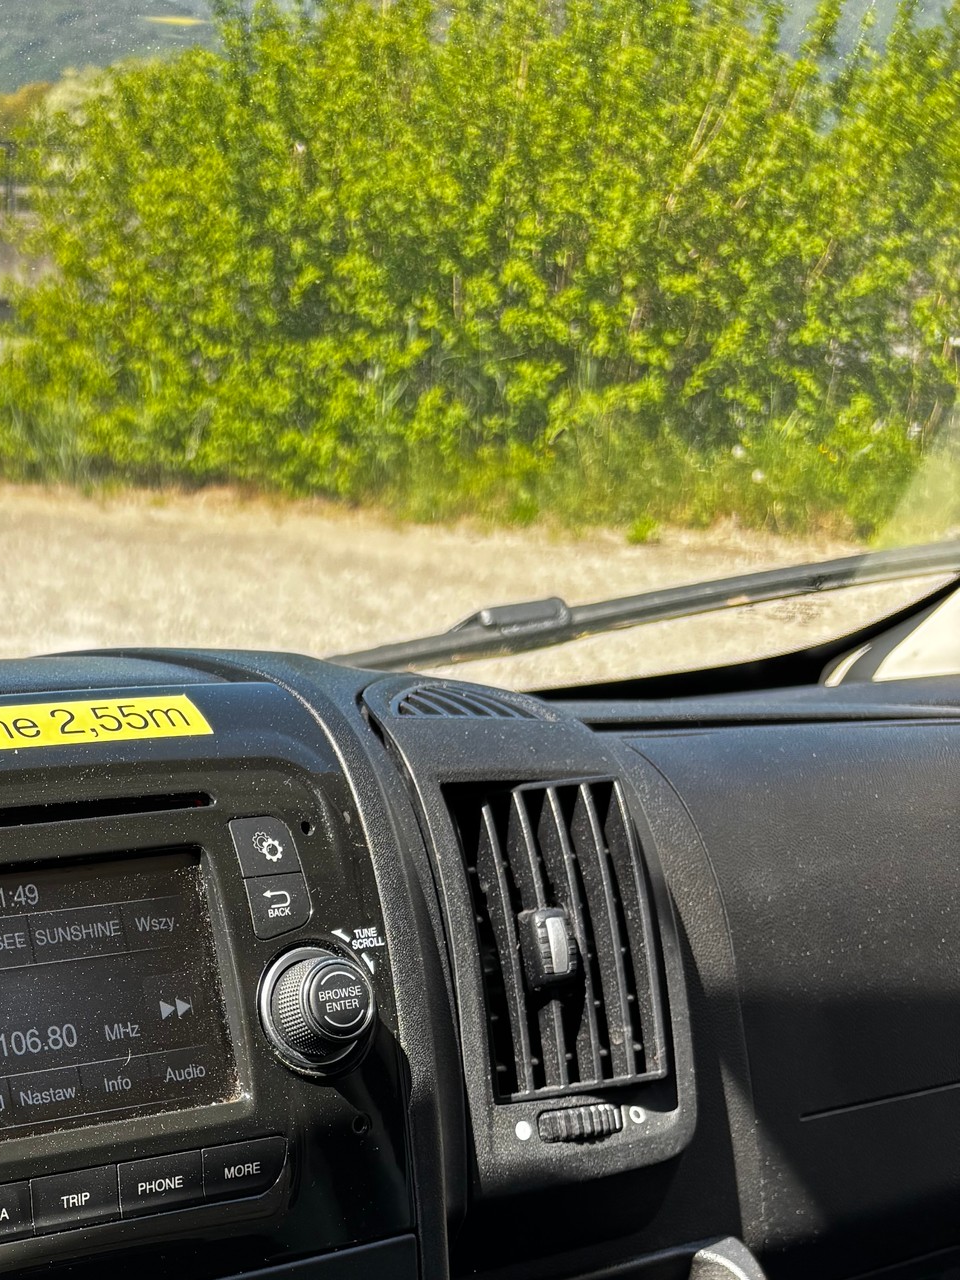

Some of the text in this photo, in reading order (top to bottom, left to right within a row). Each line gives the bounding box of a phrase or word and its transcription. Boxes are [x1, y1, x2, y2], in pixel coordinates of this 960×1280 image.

[49, 704, 192, 738] 2,55m
[268, 908, 291, 918] BACK
[36, 919, 121, 945] SUNSHINE
[135, 915, 179, 932] Wszy.
[354, 927, 378, 939] TUNE
[352, 936, 385, 949] SCROLL
[319, 986, 362, 1001] BROWSE
[326, 999, 360, 1013] ENTER
[105, 1022, 140, 1042] MHz
[166, 1064, 205, 1082] Audio
[105, 1076, 131, 1092] Info
[20, 1084, 76, 1106] Nastaw
[224, 1162, 260, 1179] MORE
[137, 1176, 183, 1194] PHONE
[60, 1192, 90, 1208] TRIP
